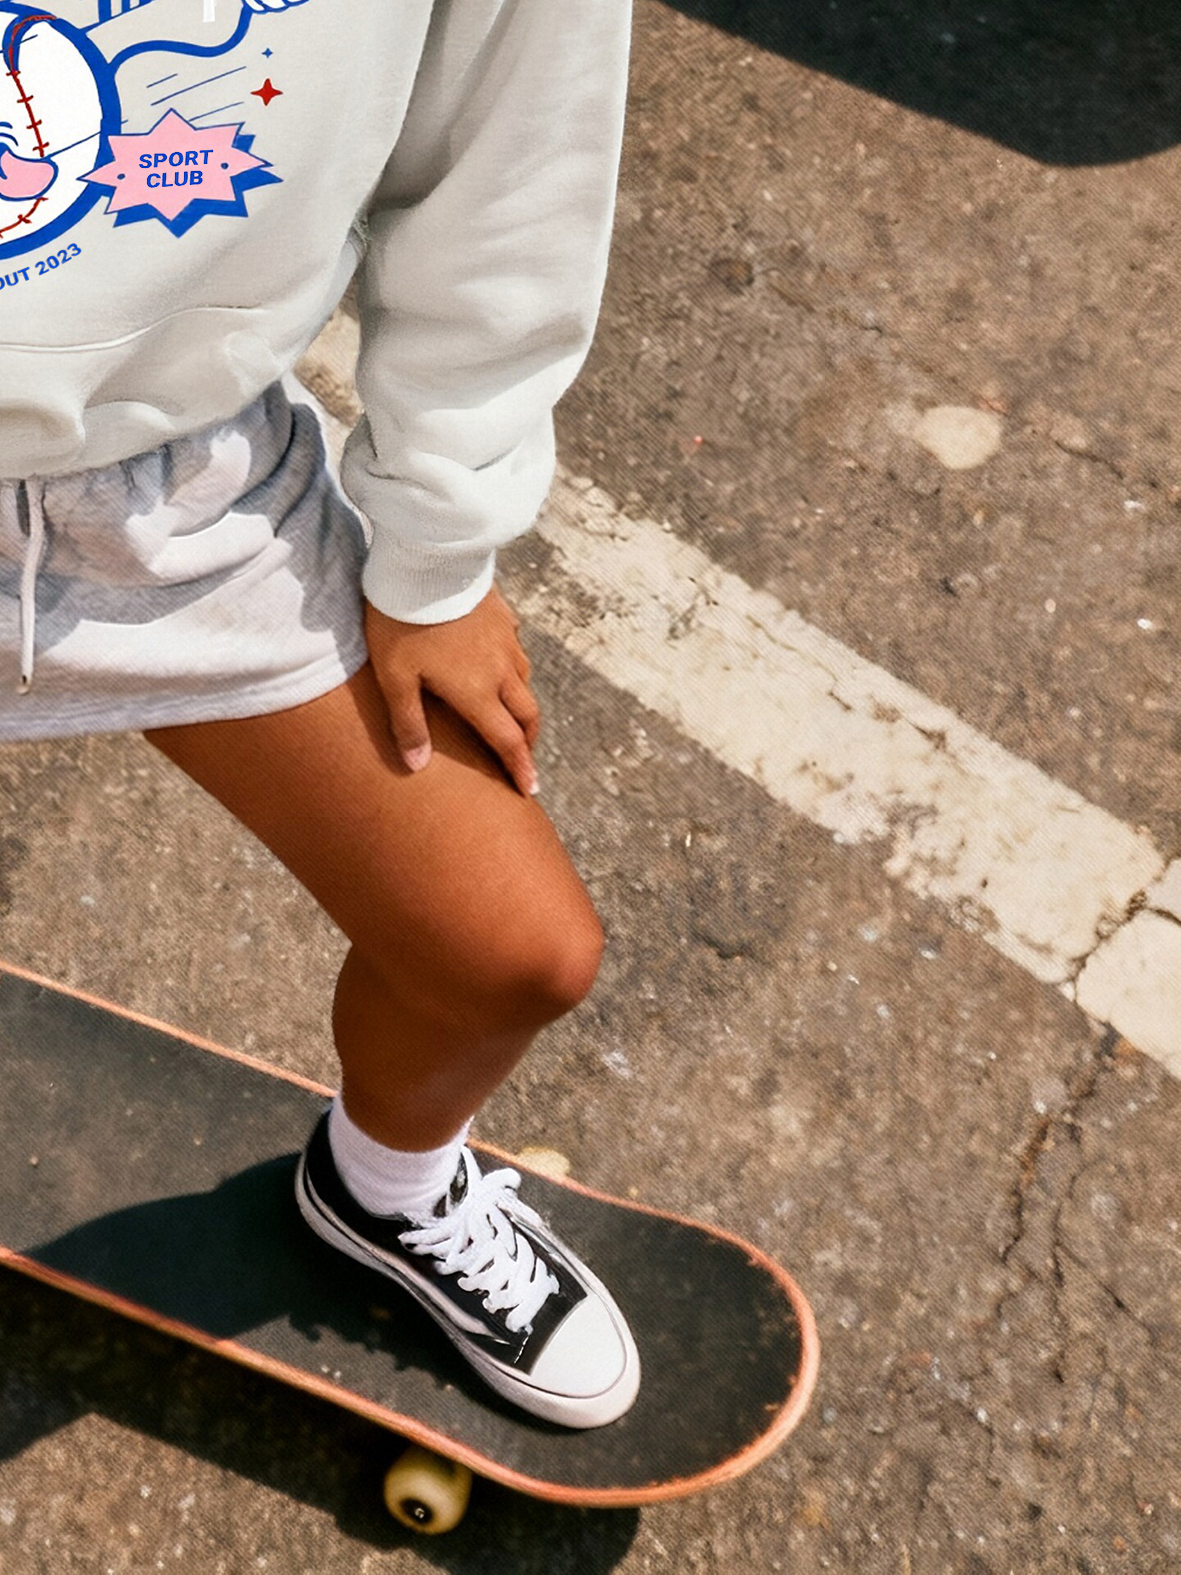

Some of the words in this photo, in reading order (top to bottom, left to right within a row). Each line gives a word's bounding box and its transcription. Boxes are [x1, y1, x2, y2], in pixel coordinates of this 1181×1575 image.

[138, 149, 214, 169] SPORT
[146, 170, 204, 188] CLUB
[35, 242, 82, 276] 2023
